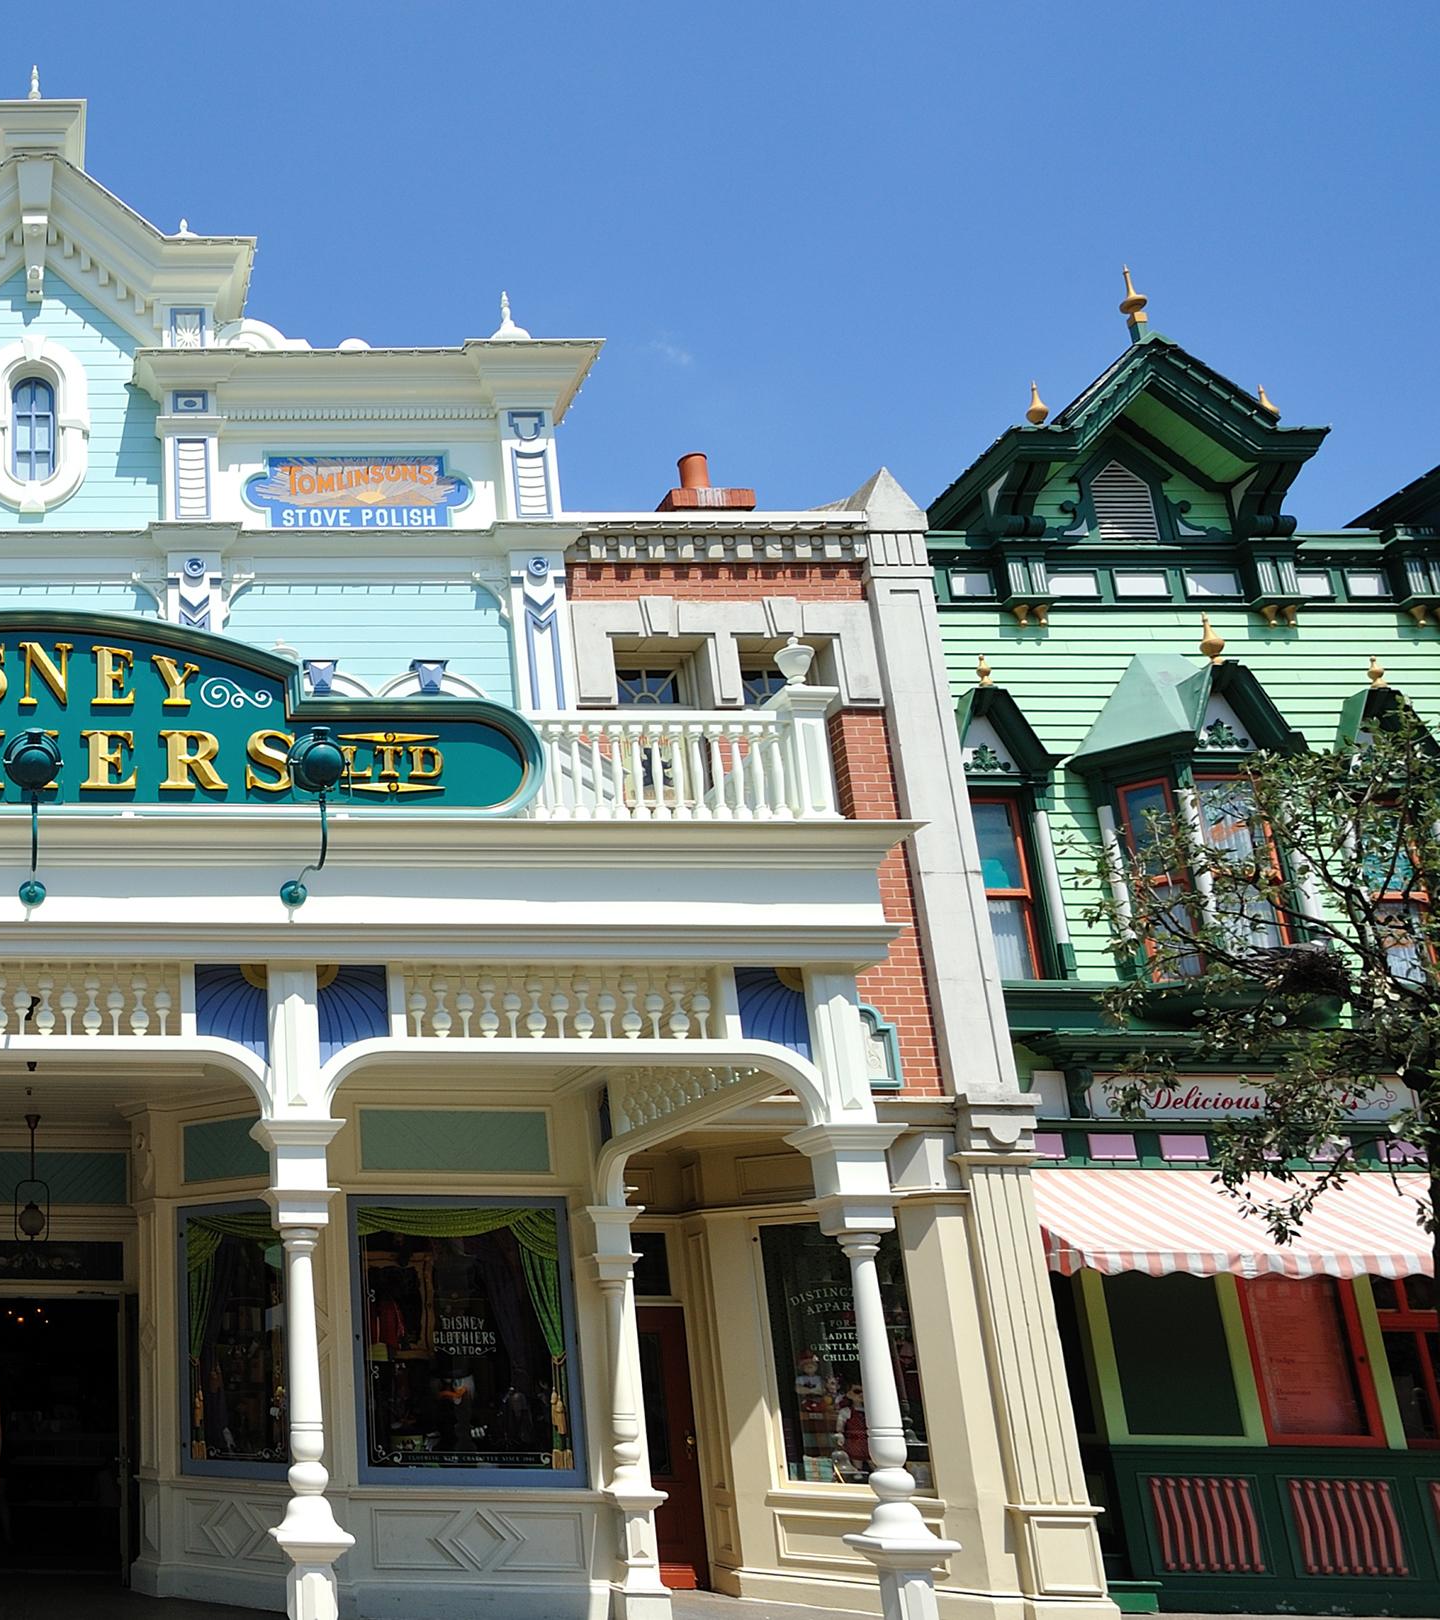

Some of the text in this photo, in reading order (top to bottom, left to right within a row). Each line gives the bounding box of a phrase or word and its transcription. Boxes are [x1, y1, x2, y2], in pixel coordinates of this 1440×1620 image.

[282, 508, 436, 527] STOVE POLISH
[340, 745, 445, 778] LTD
[1150, 1085, 1261, 1110] Delicious
[790, 1287, 854, 1307] DISTINC
[806, 1301, 855, 1315] APPAR
[441, 1316, 485, 1330] DISNEY
[830, 1319, 850, 1328] FOR
[432, 1331, 497, 1345] CLOTHIERS
